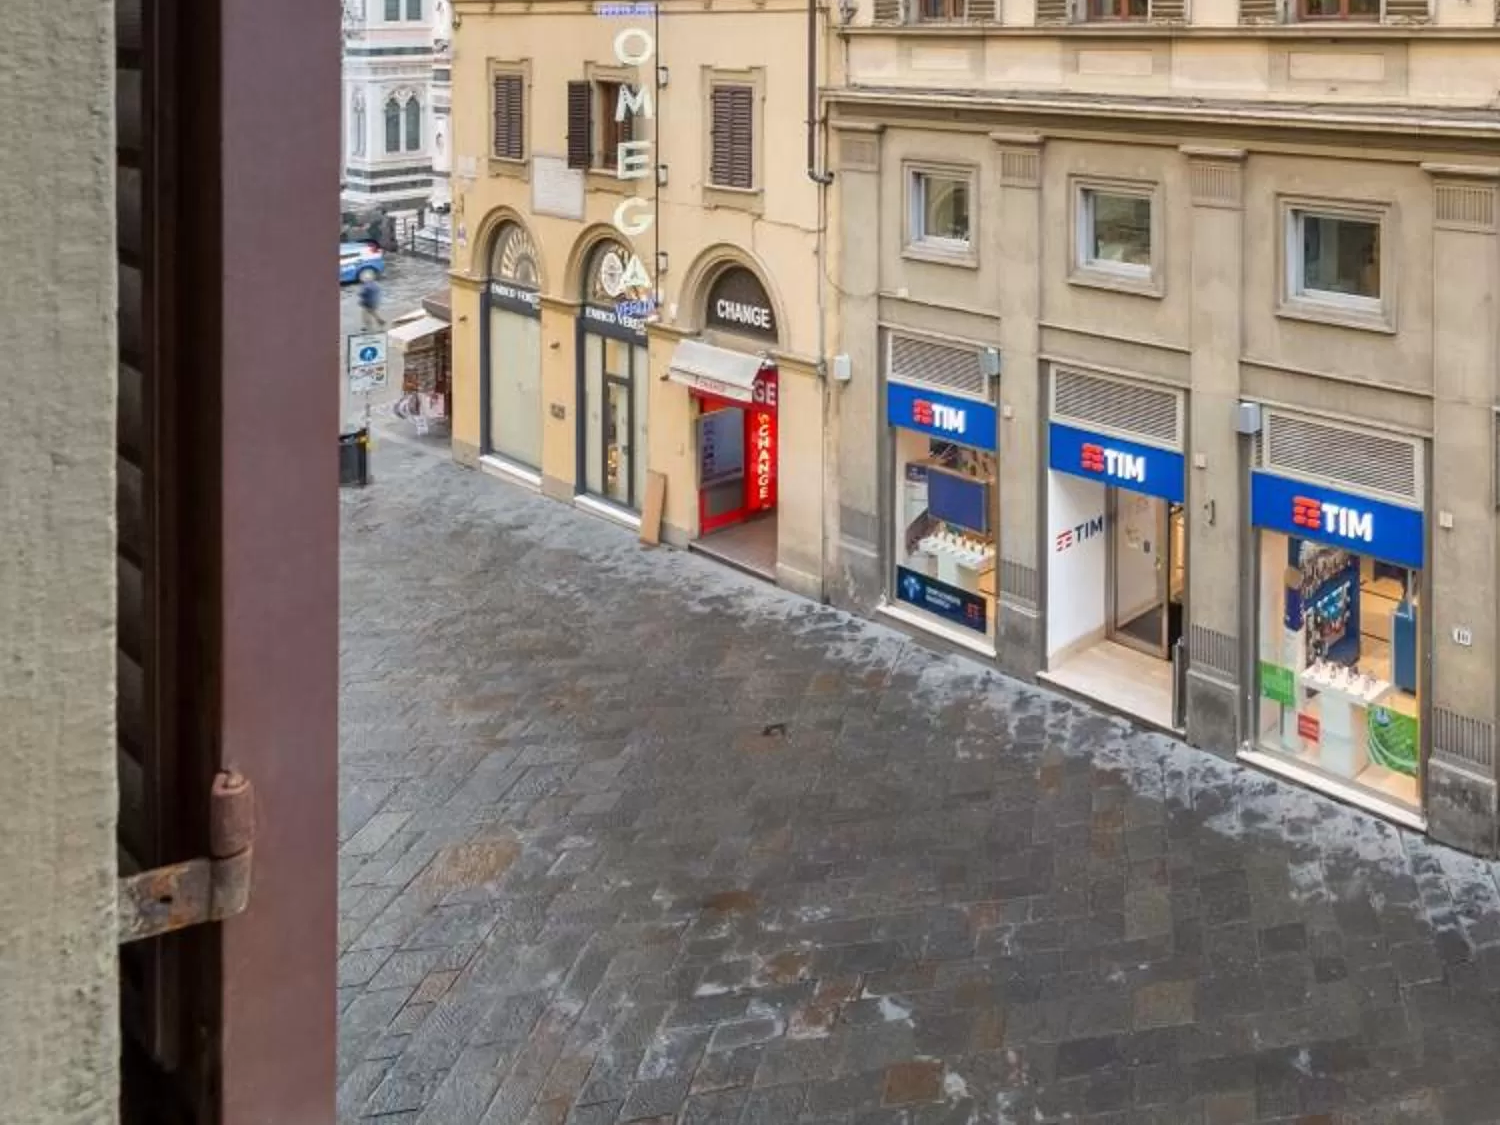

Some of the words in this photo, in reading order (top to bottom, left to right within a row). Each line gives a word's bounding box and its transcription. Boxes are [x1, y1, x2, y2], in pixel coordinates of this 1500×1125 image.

[613, 27, 655, 287] OMEGA
[716, 298, 771, 329] CHANGE
[931, 403, 966, 434] TIM
[1104, 448, 1146, 483] TIM
[1074, 514, 1103, 543] TIM
[1321, 502, 1373, 542] TIM
